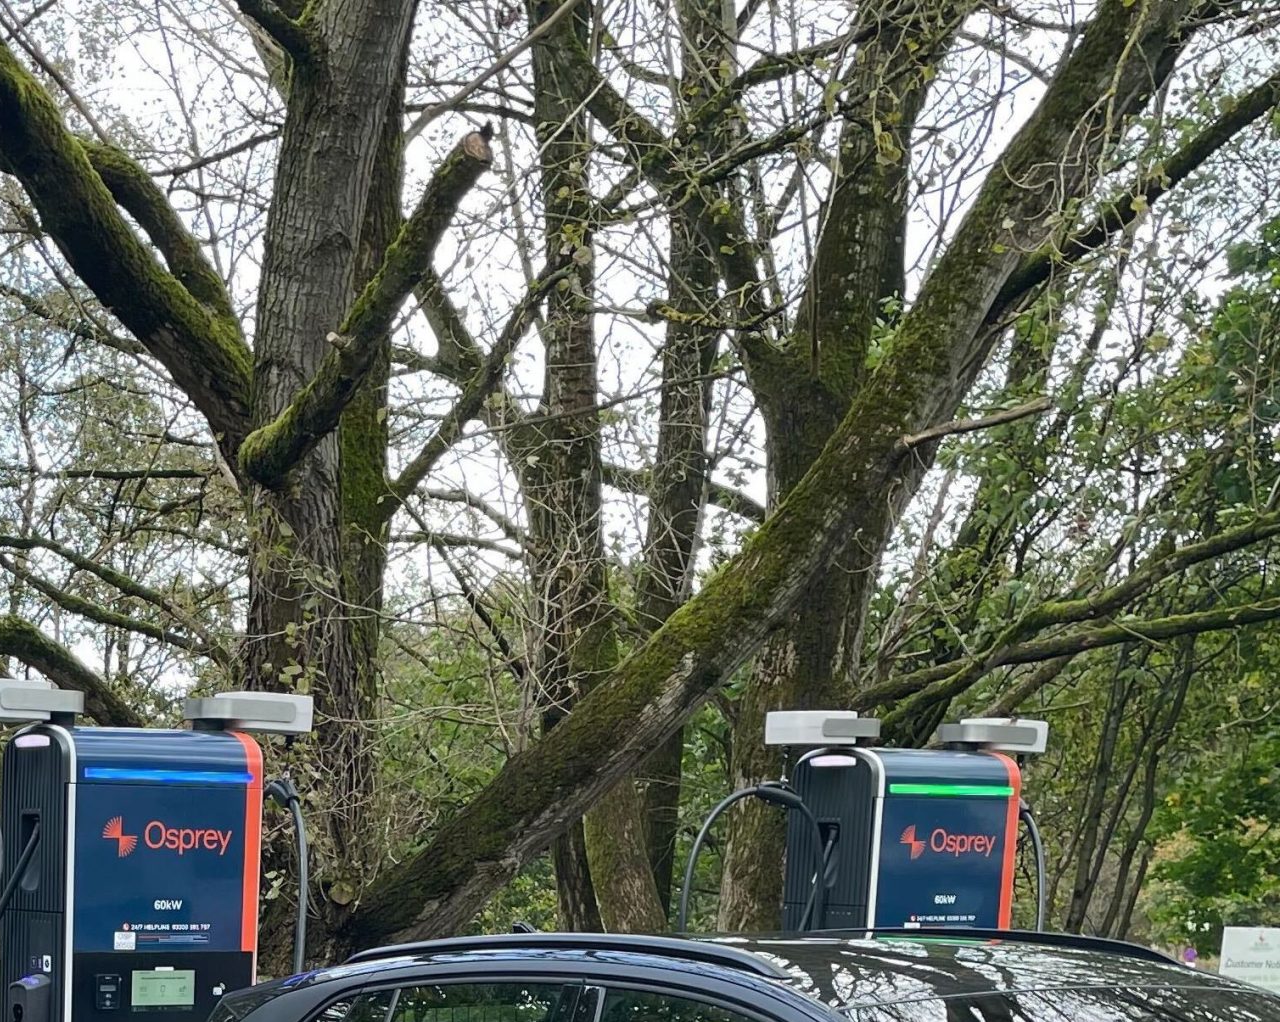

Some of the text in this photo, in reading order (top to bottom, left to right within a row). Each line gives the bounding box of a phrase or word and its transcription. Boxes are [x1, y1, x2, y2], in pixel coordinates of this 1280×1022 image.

[144, 820, 232, 856] Osprey
[930, 828, 996, 857] Osprey
[153, 899, 182, 910] 60kW
[1225, 957, 1264, 968] Customer
